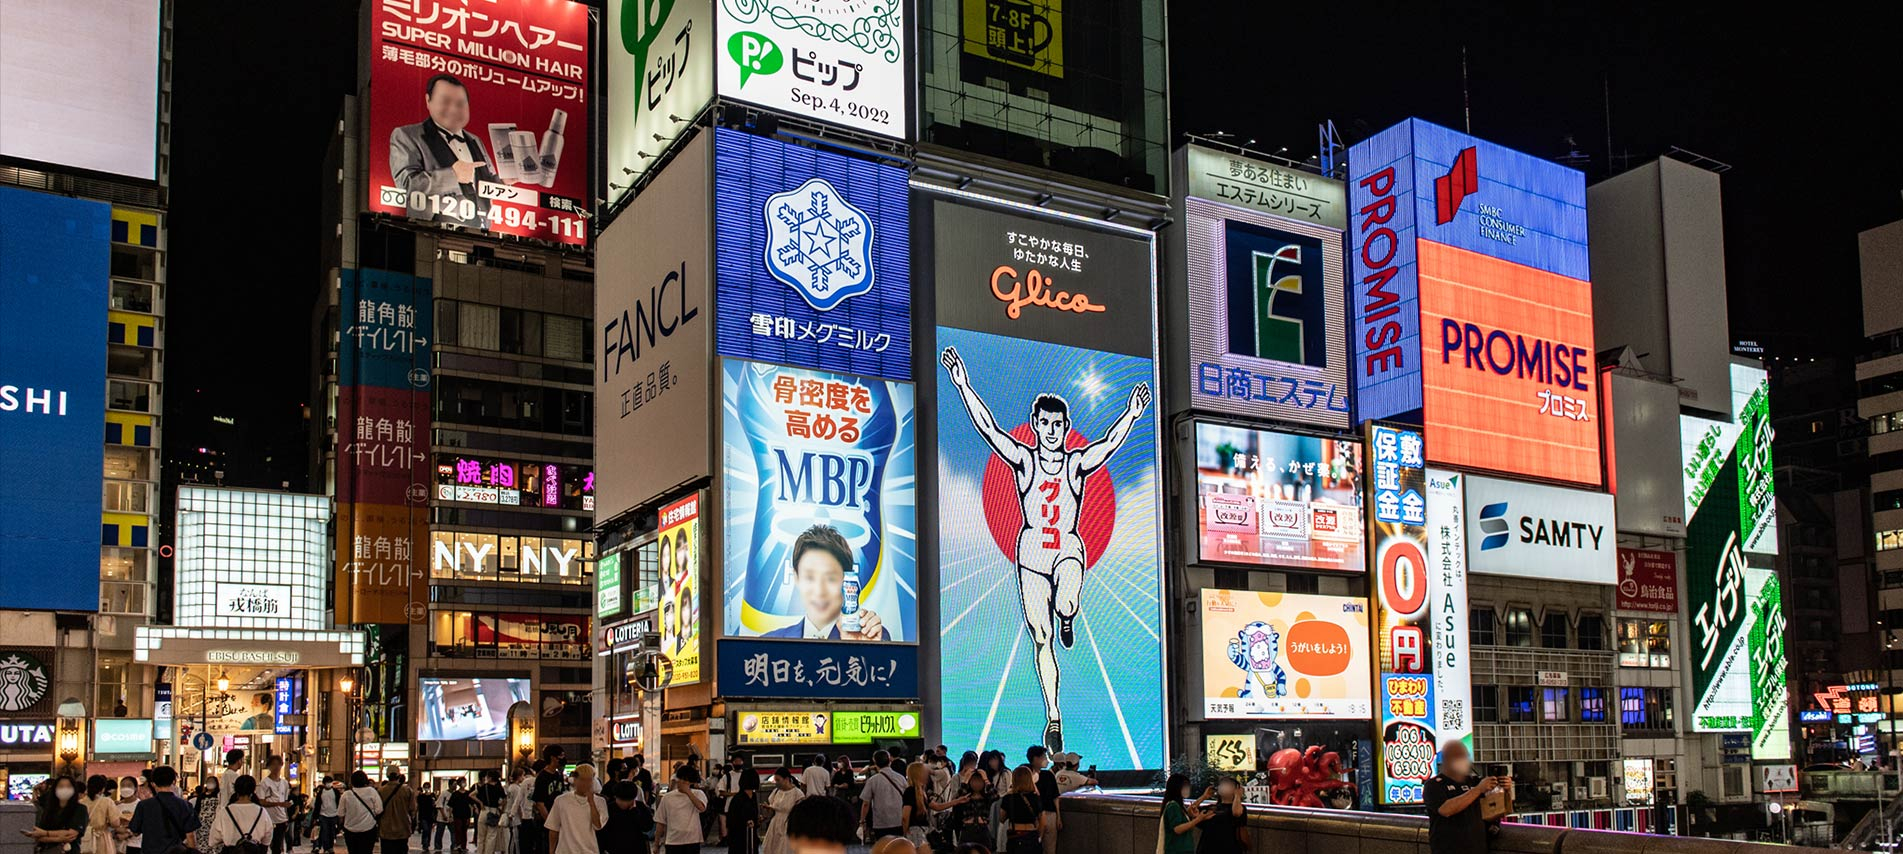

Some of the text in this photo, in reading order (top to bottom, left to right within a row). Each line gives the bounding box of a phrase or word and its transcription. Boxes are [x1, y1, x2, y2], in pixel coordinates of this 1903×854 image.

[382, 0, 583, 51] ミリオンヘアー
[988, 25, 1034, 55] 頭上!
[382, 22, 583, 79] SUPER MILLION HAIR
[648, 19, 692, 111] ピップ
[382, 45, 583, 102] 薄毛部分のボリュームアップ!
[792, 47, 863, 91] ピップ
[791, 87, 889, 125] Sep. 4, 2022
[1229, 159, 1307, 191] 夢ある住まい
[482, 185, 518, 199] ルアン
[549, 196, 572, 211] 検索
[1216, 183, 1321, 220] エステムシリーズ
[410, 191, 583, 238] 0120-494-111
[1479, 203, 1502, 218] SMBC
[1479, 215, 1525, 237] CONSUMER
[1007, 231, 1090, 259] すこやかな毎日、
[1480, 227, 1517, 246] FINANCE
[1013, 248, 1082, 273] ゆたかな人生
[1360, 167, 1402, 376] PROMISE
[990, 265, 1106, 320] Glico
[358, 299, 416, 328] 龍角散
[604, 261, 698, 383] FANCL
[750, 313, 891, 352] 雪印メグミルク
[1442, 318, 1588, 391] PROMISE
[0, 385, 67, 416] SHI
[620, 361, 677, 418] 正直品質。
[773, 376, 872, 414] 骨密度を
[1199, 362, 1350, 412] 日商エステム
[1537, 389, 1590, 421] プロミス
[356, 416, 415, 443] 龍角散
[784, 409, 861, 444] 高める
[1233, 452, 1338, 479] 備える、かぜ薬。
[1742, 414, 1775, 494] エイブル
[457, 459, 513, 487] 焼肉
[774, 448, 869, 508] MBP
[1375, 432, 1399, 520] 保証金
[1430, 477, 1450, 490] Asue
[1039, 477, 1062, 550] グリコ
[354, 536, 413, 560] 龍角散
[1519, 515, 1603, 551] SAMTY
[434, 541, 493, 572] NY
[523, 545, 577, 576] NY
[1440, 526, 1453, 587] 株式会社
[229, 598, 279, 614] 戎橋筋
[1343, 603, 1363, 613] CHINTAI
[1695, 530, 1748, 671] エイブル
[615, 620, 650, 642] LOTTERIA
[1443, 592, 1456, 668] Asue
[1290, 642, 1347, 655] うがいをしよう!
[744, 653, 897, 687] 明日を、元気に!
[1388, 679, 1427, 695] ひまわり
[1210, 704, 1235, 713] 天気予報
[1391, 699, 1426, 716] 不動産
[1804, 712, 1827, 720] Asahi
[1, 725, 55, 743] UTA
[860, 715, 896, 733] ピタットハウス
[1401, 729, 1418, 744] 06
[1388, 745, 1432, 761] (6641)
[1394, 760, 1427, 776] 6304
